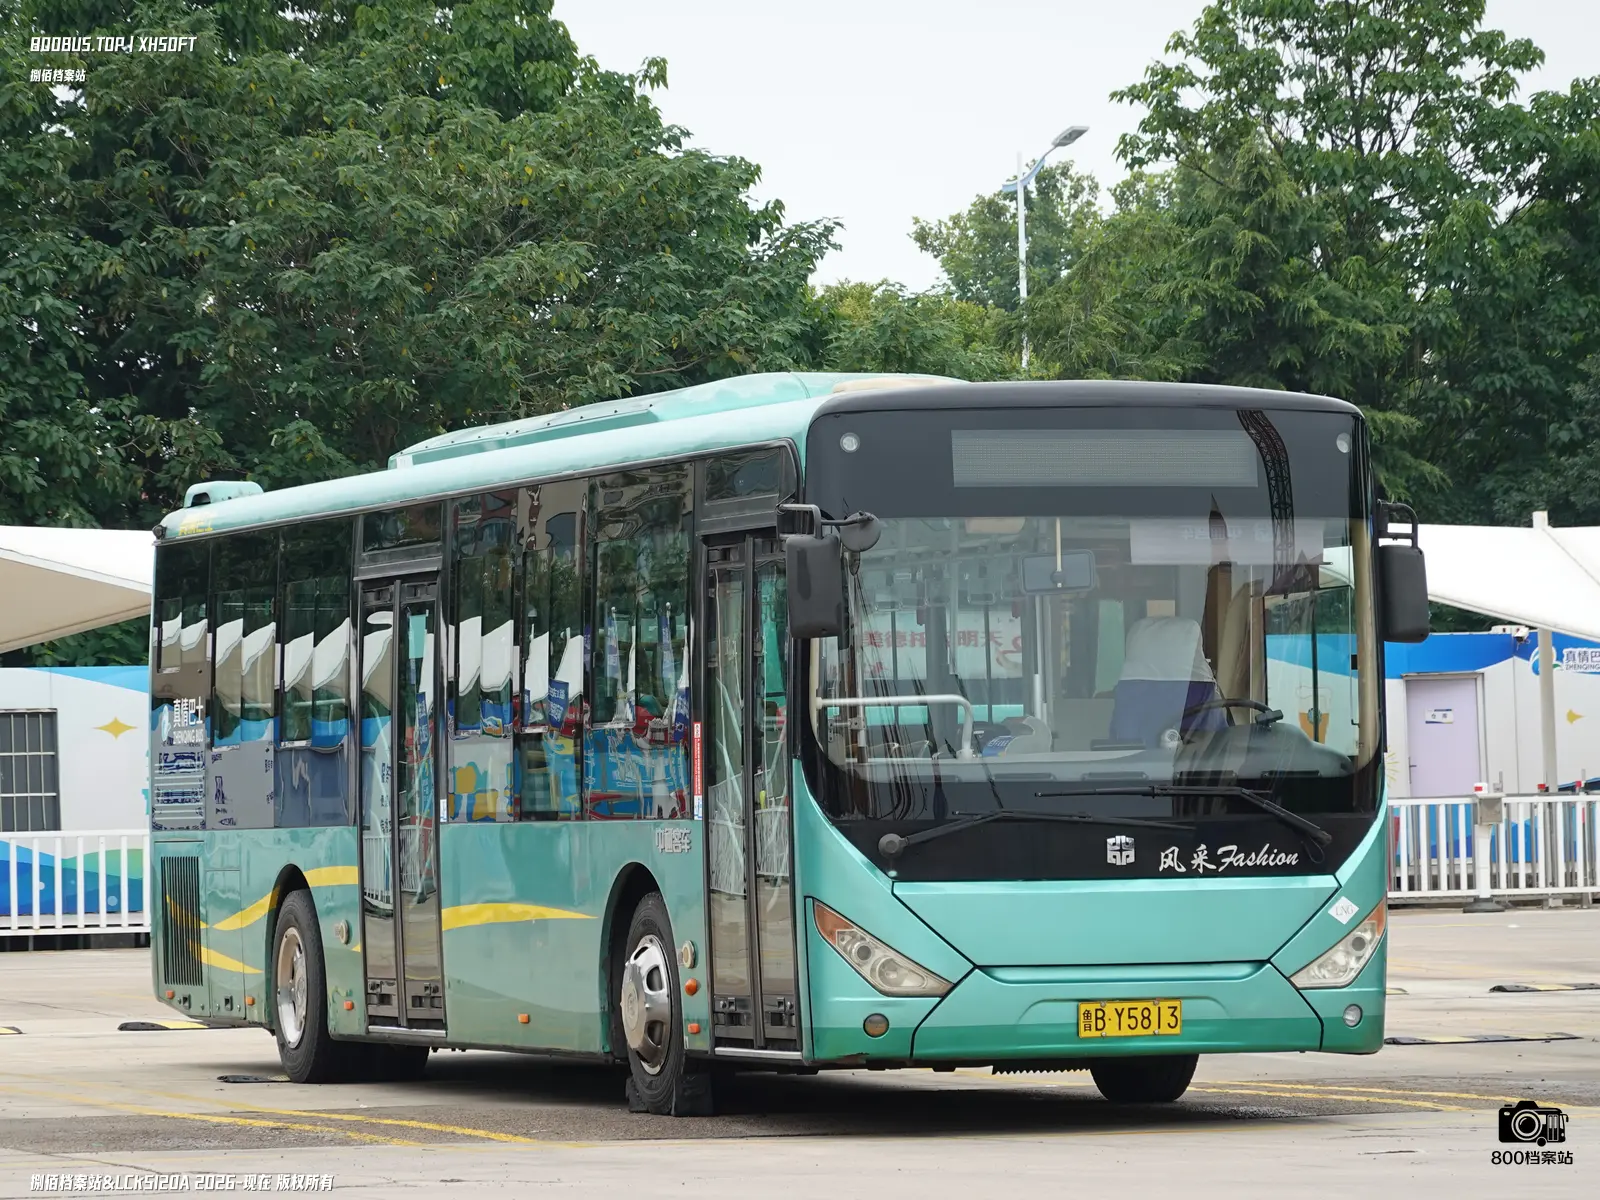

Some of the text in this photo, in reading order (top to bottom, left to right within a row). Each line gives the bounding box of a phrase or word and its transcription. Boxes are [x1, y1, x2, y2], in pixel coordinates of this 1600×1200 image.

[173, 696, 204, 727] 真情巴士
[1159, 843, 1300, 874] 风采 Fashion
